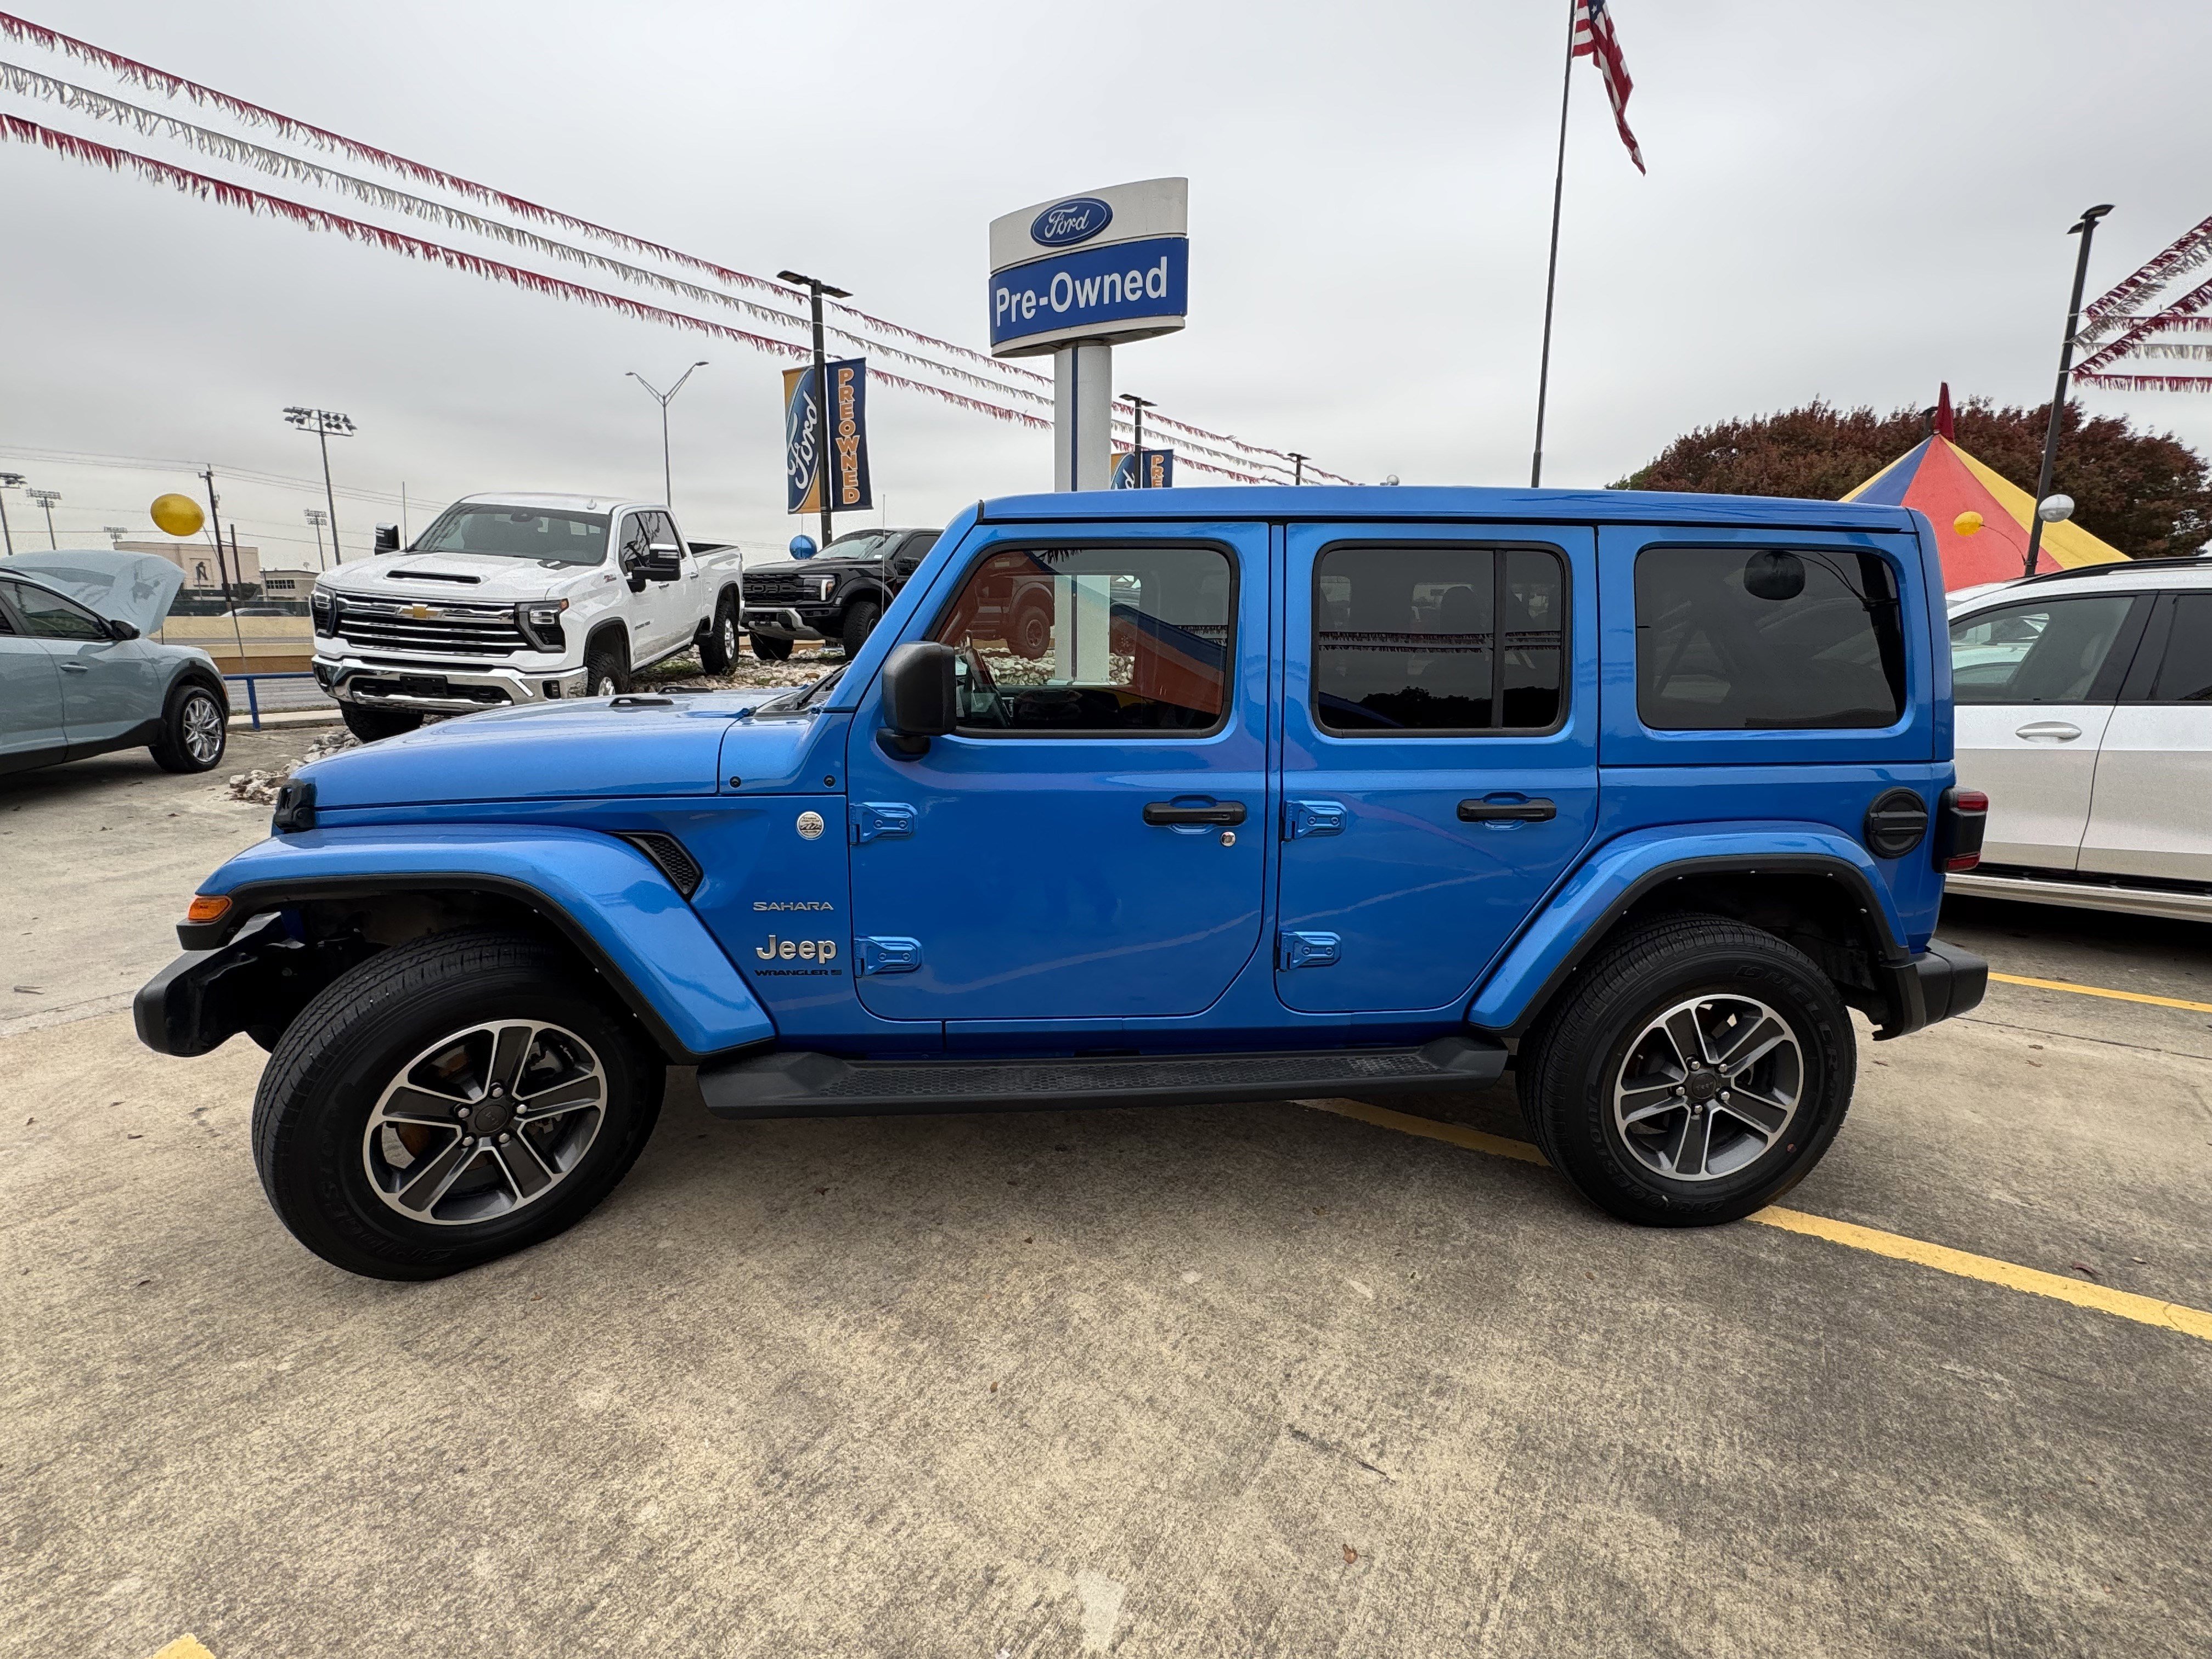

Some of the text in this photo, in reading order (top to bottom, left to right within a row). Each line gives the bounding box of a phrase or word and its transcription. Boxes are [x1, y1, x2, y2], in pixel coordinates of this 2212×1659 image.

[1044, 206, 1090, 239] Ford
[996, 256, 1168, 327] Pre-Owned
[787, 390, 819, 490] Ford
[753, 901, 834, 911] SAHARA
[755, 934, 837, 964] Jeep
